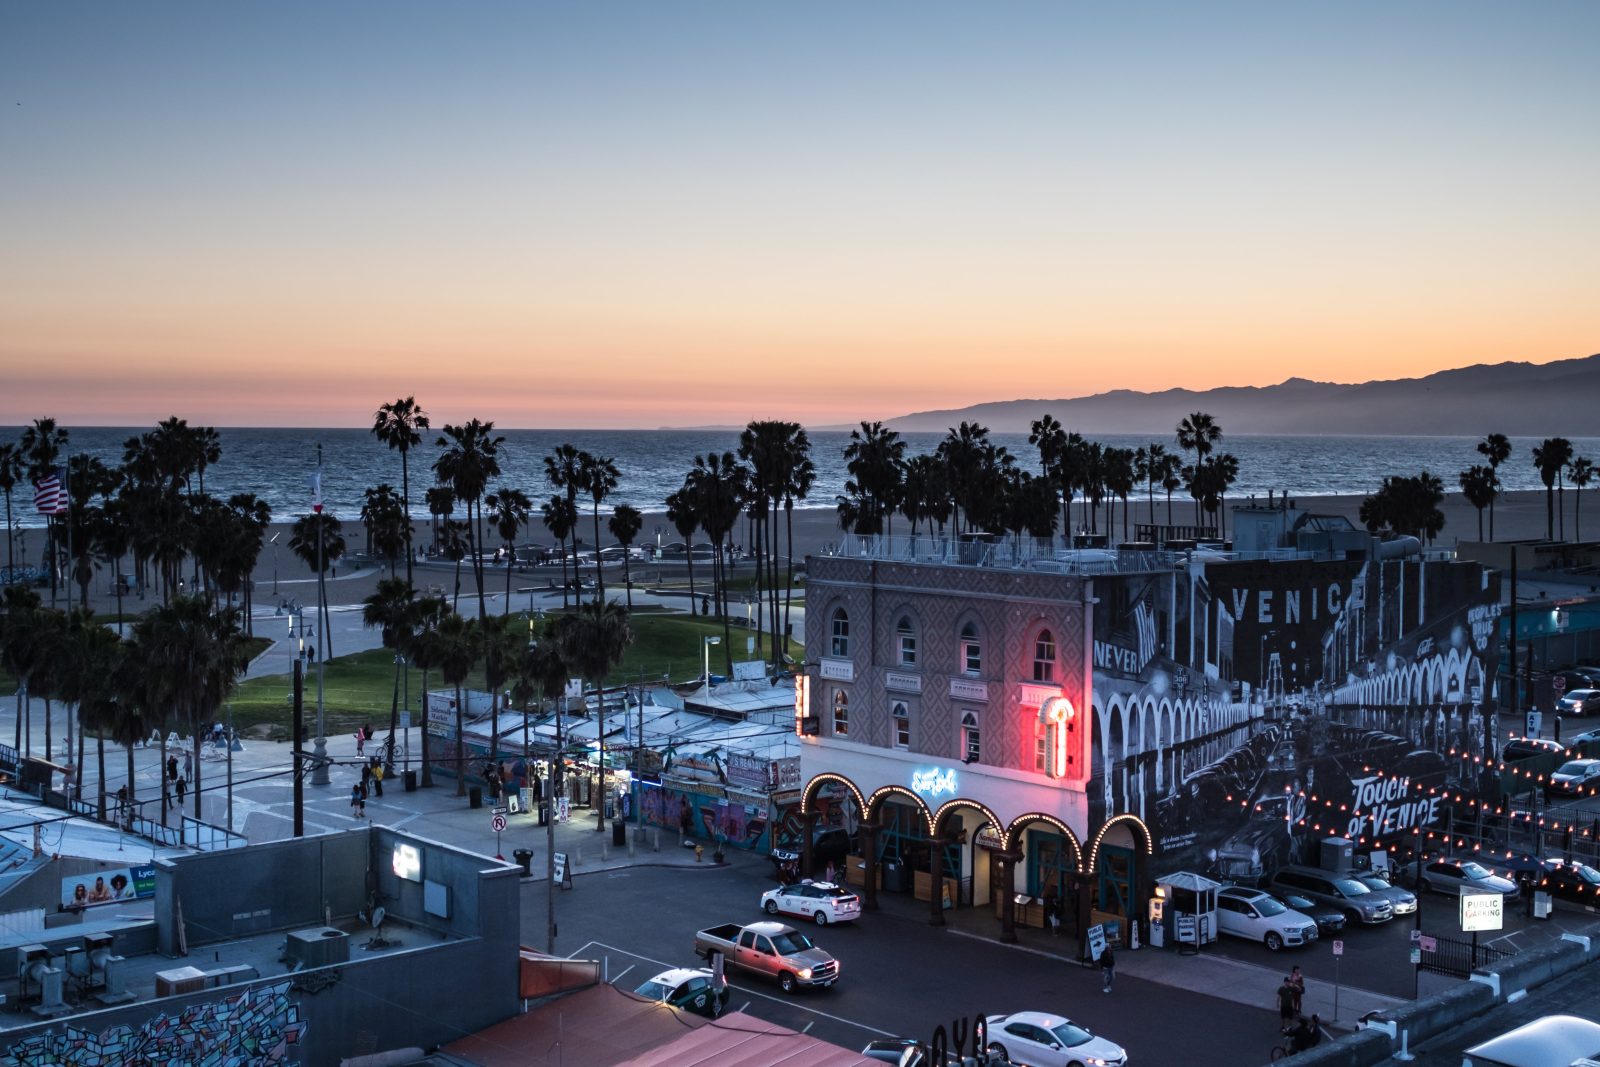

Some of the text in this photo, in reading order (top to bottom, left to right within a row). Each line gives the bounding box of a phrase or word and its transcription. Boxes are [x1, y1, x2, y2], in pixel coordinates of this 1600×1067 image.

[1232, 582, 1366, 625] VENICE
[1093, 640, 1138, 675] NEVER
[1352, 776, 1410, 814] TOUCH
[1348, 814, 1369, 838] OF
[1371, 796, 1442, 837] VENICE
[1465, 909, 1500, 918] PARKING
[1467, 899, 1498, 908] PUBLIC
[1089, 926, 1102, 935] PUBLIC
